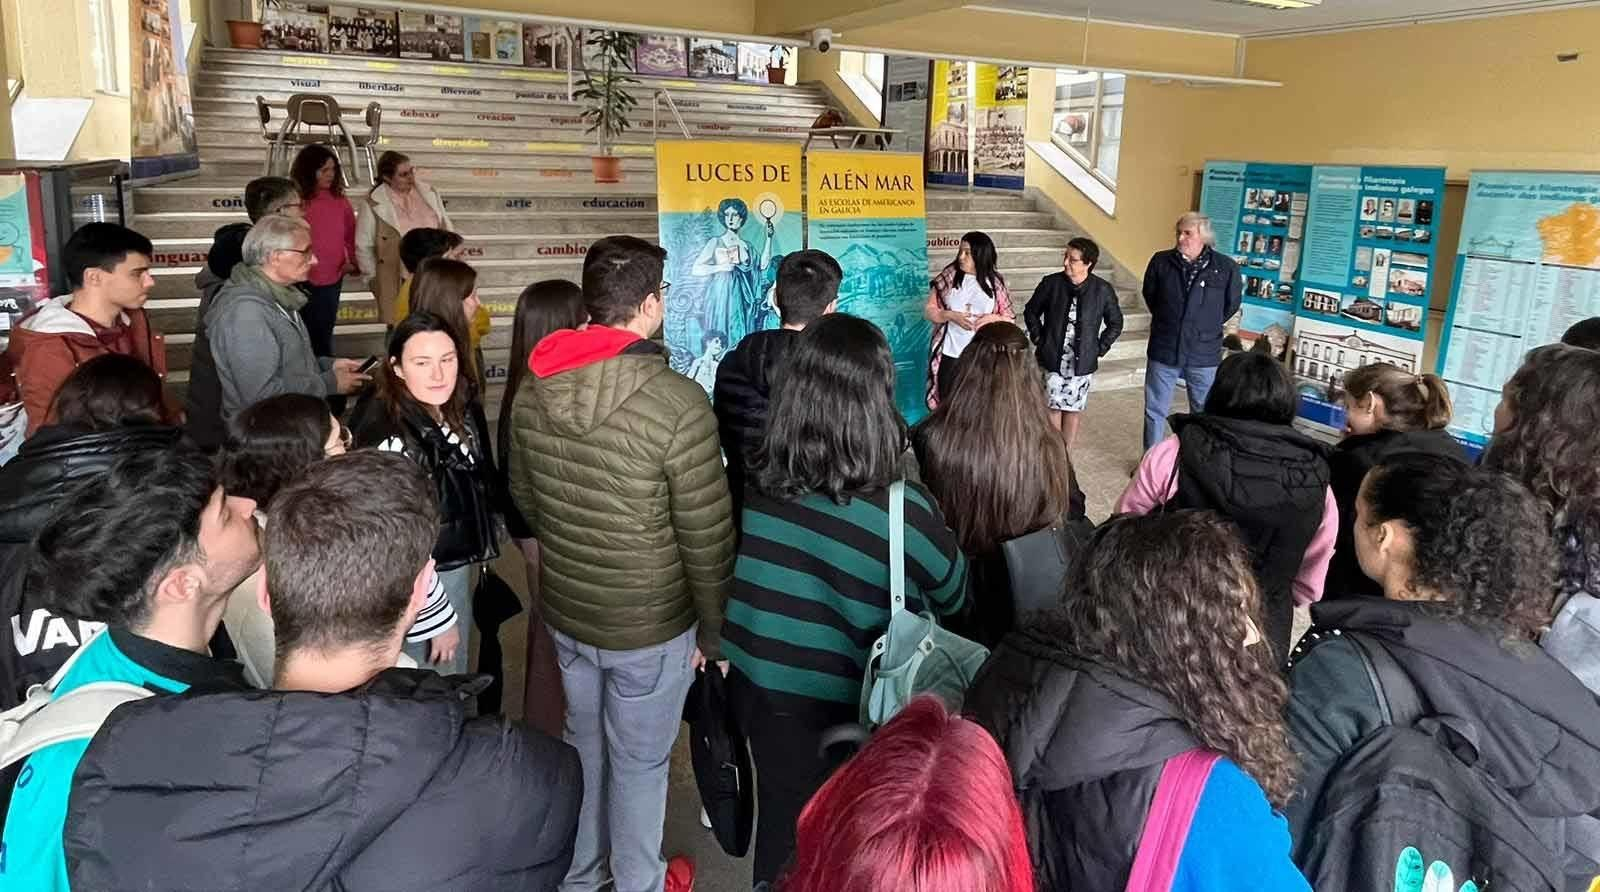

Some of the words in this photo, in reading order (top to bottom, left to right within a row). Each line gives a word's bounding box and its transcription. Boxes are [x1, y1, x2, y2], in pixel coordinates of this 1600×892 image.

[291, 79, 321, 88] visual
[400, 109, 439, 119] debuxar
[685, 163, 755, 182] LUCES
[761, 164, 791, 183] DE
[819, 169, 869, 192] ALÉN
[874, 175, 915, 193] MAR
[506, 198, 532, 208] arte
[582, 196, 645, 209] educación
[830, 198, 861, 207] ESCOLAS
[862, 199, 871, 207] DE
[872, 199, 916, 207] AMERICANOS
[819, 206, 830, 214] EN
[831, 206, 861, 214] GALICIA
[537, 242, 587, 256] cambio
